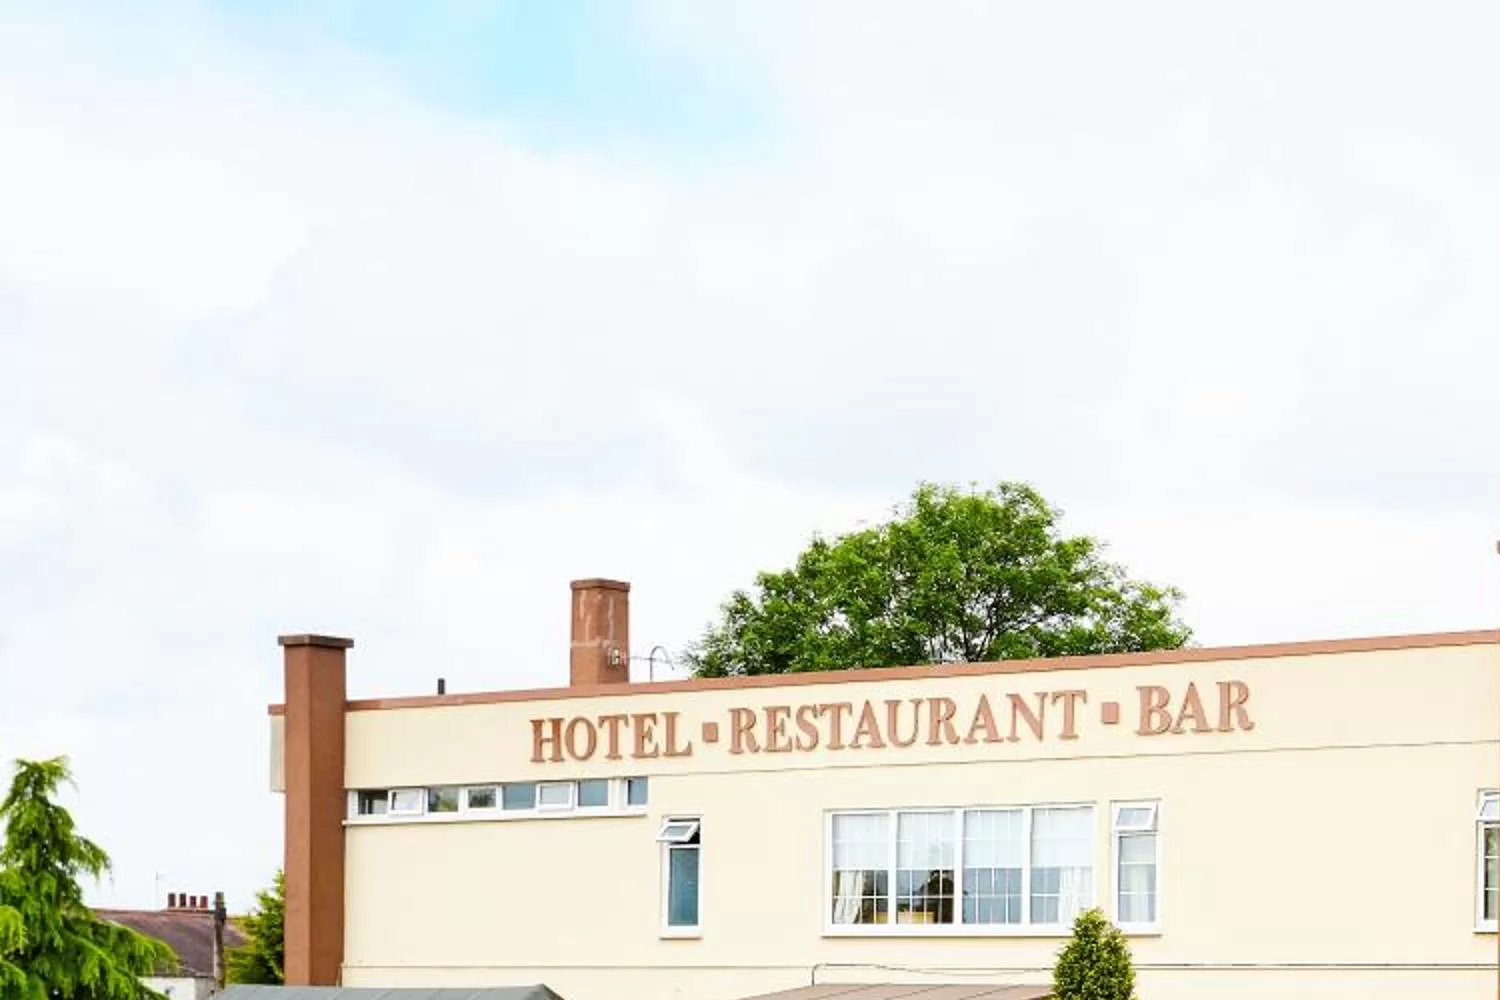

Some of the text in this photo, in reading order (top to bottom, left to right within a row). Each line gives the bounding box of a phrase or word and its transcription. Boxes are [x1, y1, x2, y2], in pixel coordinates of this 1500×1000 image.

[530, 679, 1256, 763] HOTEL RESTAURANT BAR
